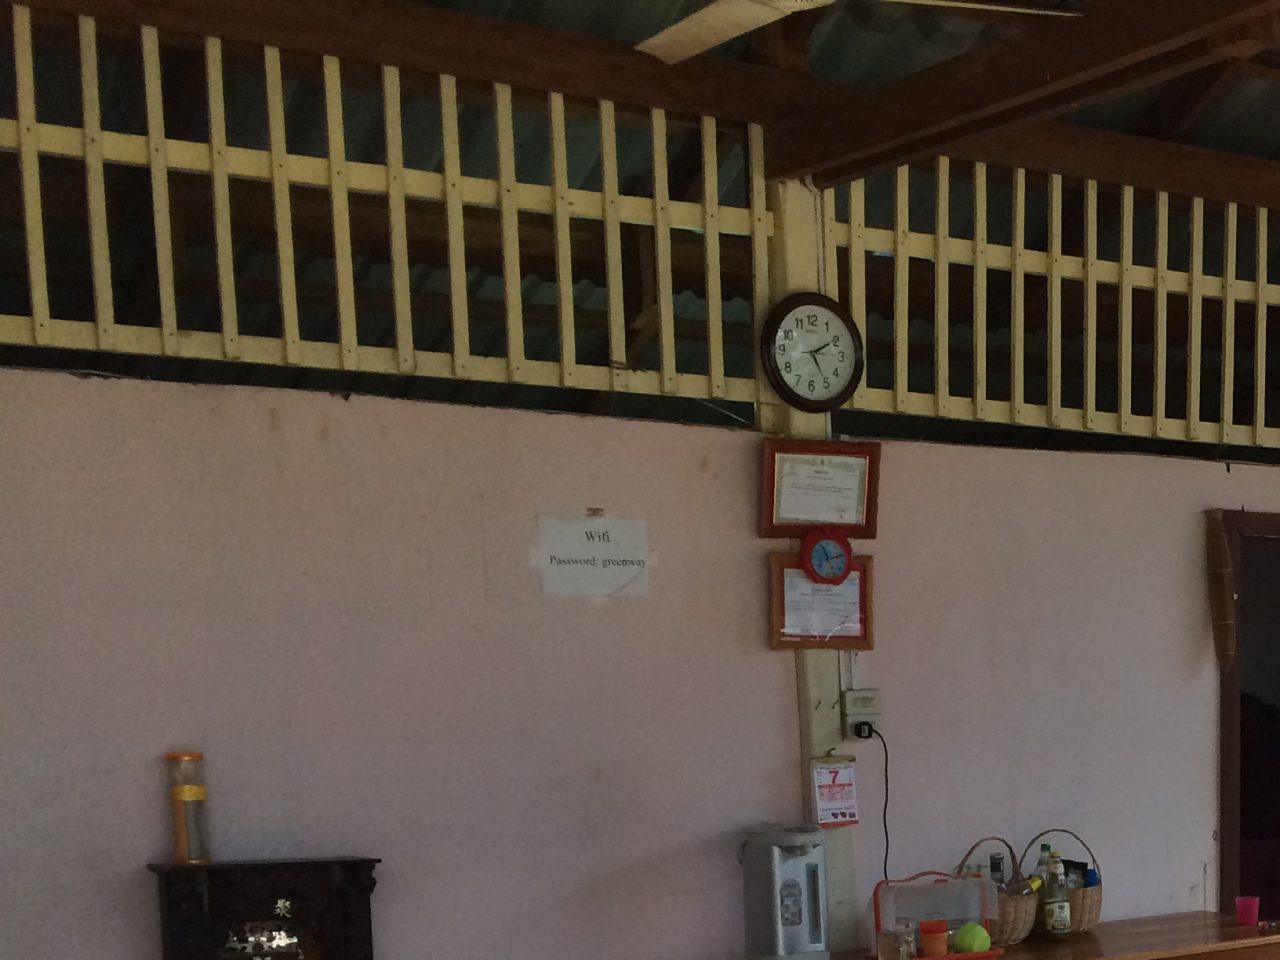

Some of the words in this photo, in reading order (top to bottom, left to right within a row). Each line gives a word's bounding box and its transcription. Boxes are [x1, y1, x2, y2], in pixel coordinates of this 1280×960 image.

[795, 318, 804, 329] 11
[806, 314, 818, 327] 12
[825, 321, 830, 333] 1
[783, 329, 794, 341] 10
[833, 336, 840, 347] 2
[779, 344, 786, 356] 9
[838, 351, 845, 362] 3
[784, 362, 792, 374] 8
[833, 368, 839, 378] 4
[795, 374, 802, 386] 7
[808, 380, 815, 392] 6
[823, 377, 830, 389] 5
[585, 531, 611, 543] Wifi
[602, 558, 646, 569] greenway
[829, 770, 839, 785] 7
